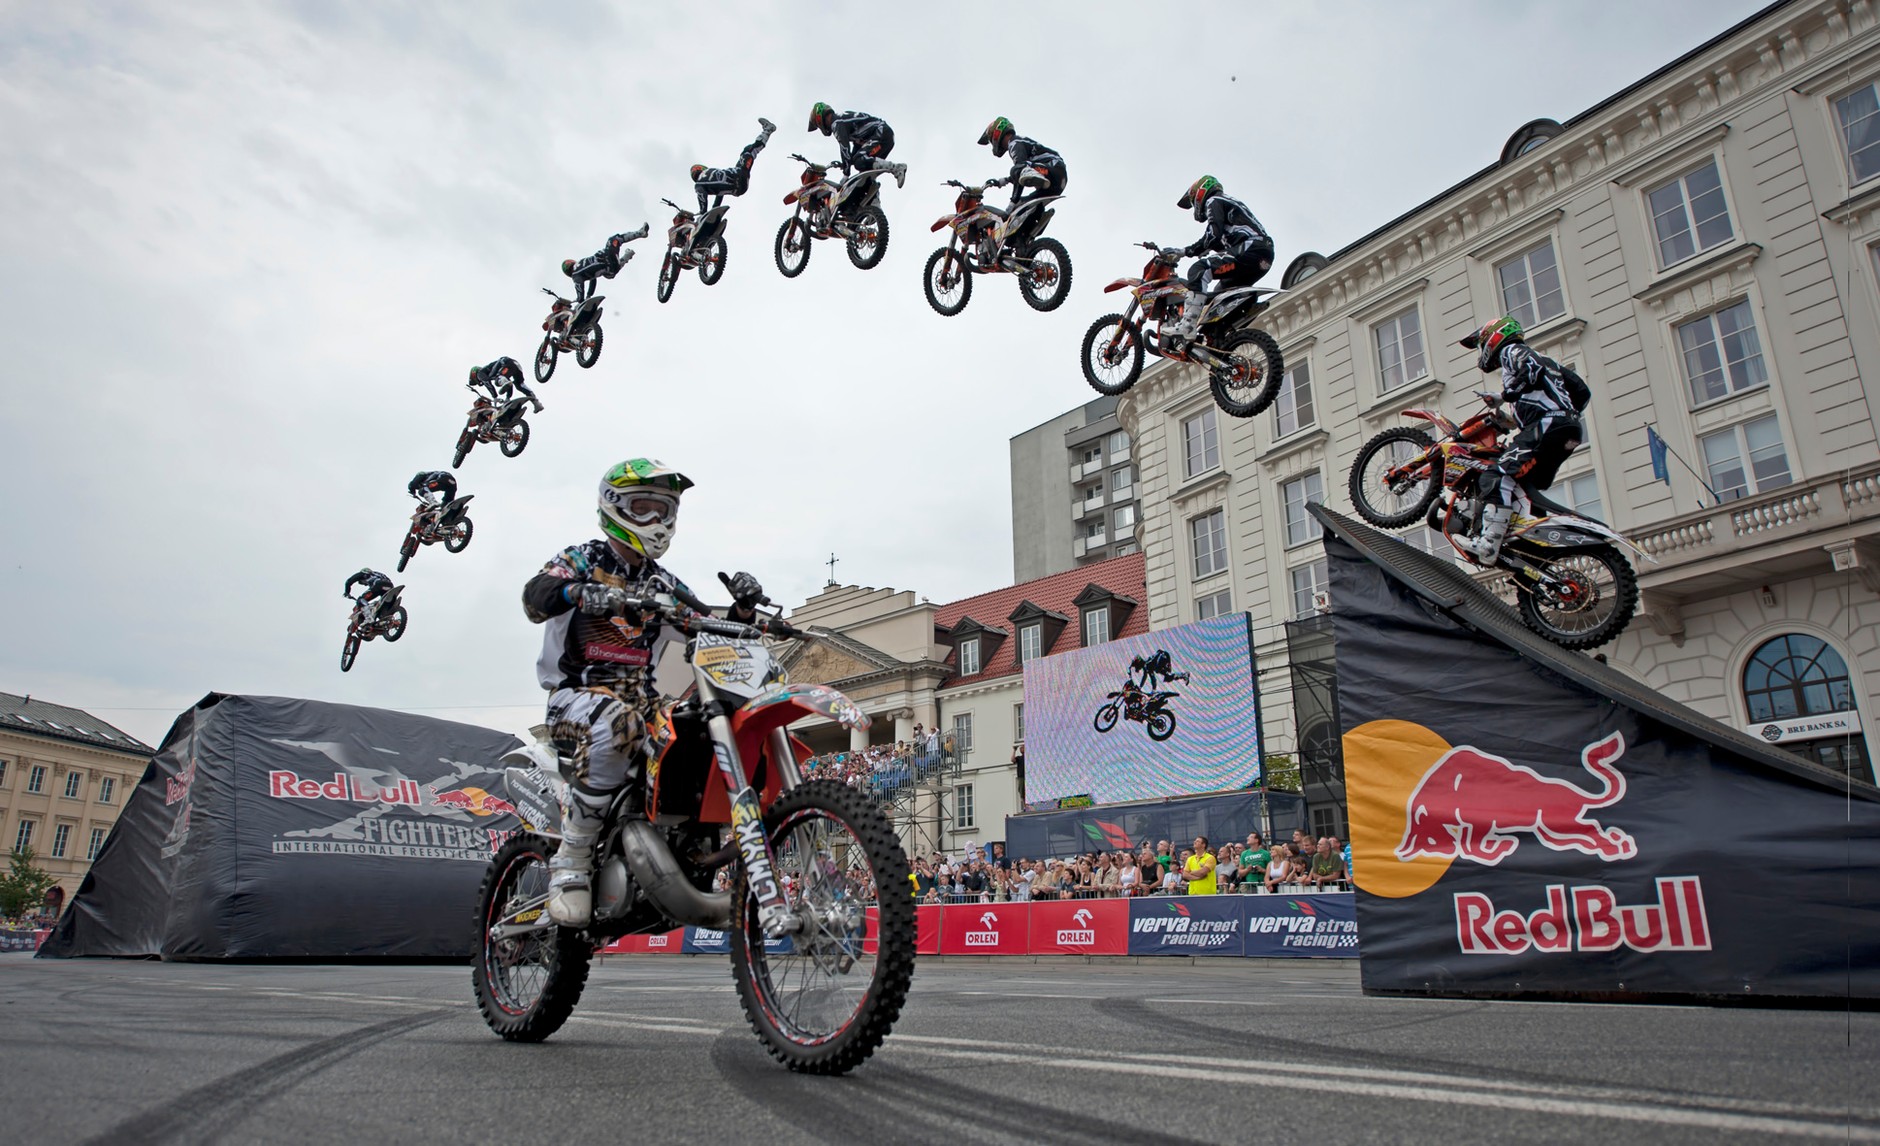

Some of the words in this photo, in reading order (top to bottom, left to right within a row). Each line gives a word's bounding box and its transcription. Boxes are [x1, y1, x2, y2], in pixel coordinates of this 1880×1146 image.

[1787, 725, 1806, 734] BRE
[1807, 721, 1833, 732] BANK
[1834, 719, 1847, 728] SA
[269, 769, 349, 801] Red
[362, 817, 487, 850] FIGHTERS
[276, 842, 395, 856] INTERNATIONAL
[402, 847, 470, 859] FREESTYLE
[736, 819, 777, 899] CMYK
[1454, 884, 1572, 955] Red
[1571, 876, 1712, 953] Bull
[1133, 917, 1191, 933] verva
[1189, 919, 1239, 932] street
[1249, 916, 1317, 933] verva
[967, 933, 997, 944] ORLEN
[1058, 931, 1092, 943] ORLEN
[1161, 932, 1209, 947] racing
[1282, 933, 1340, 948] racing
